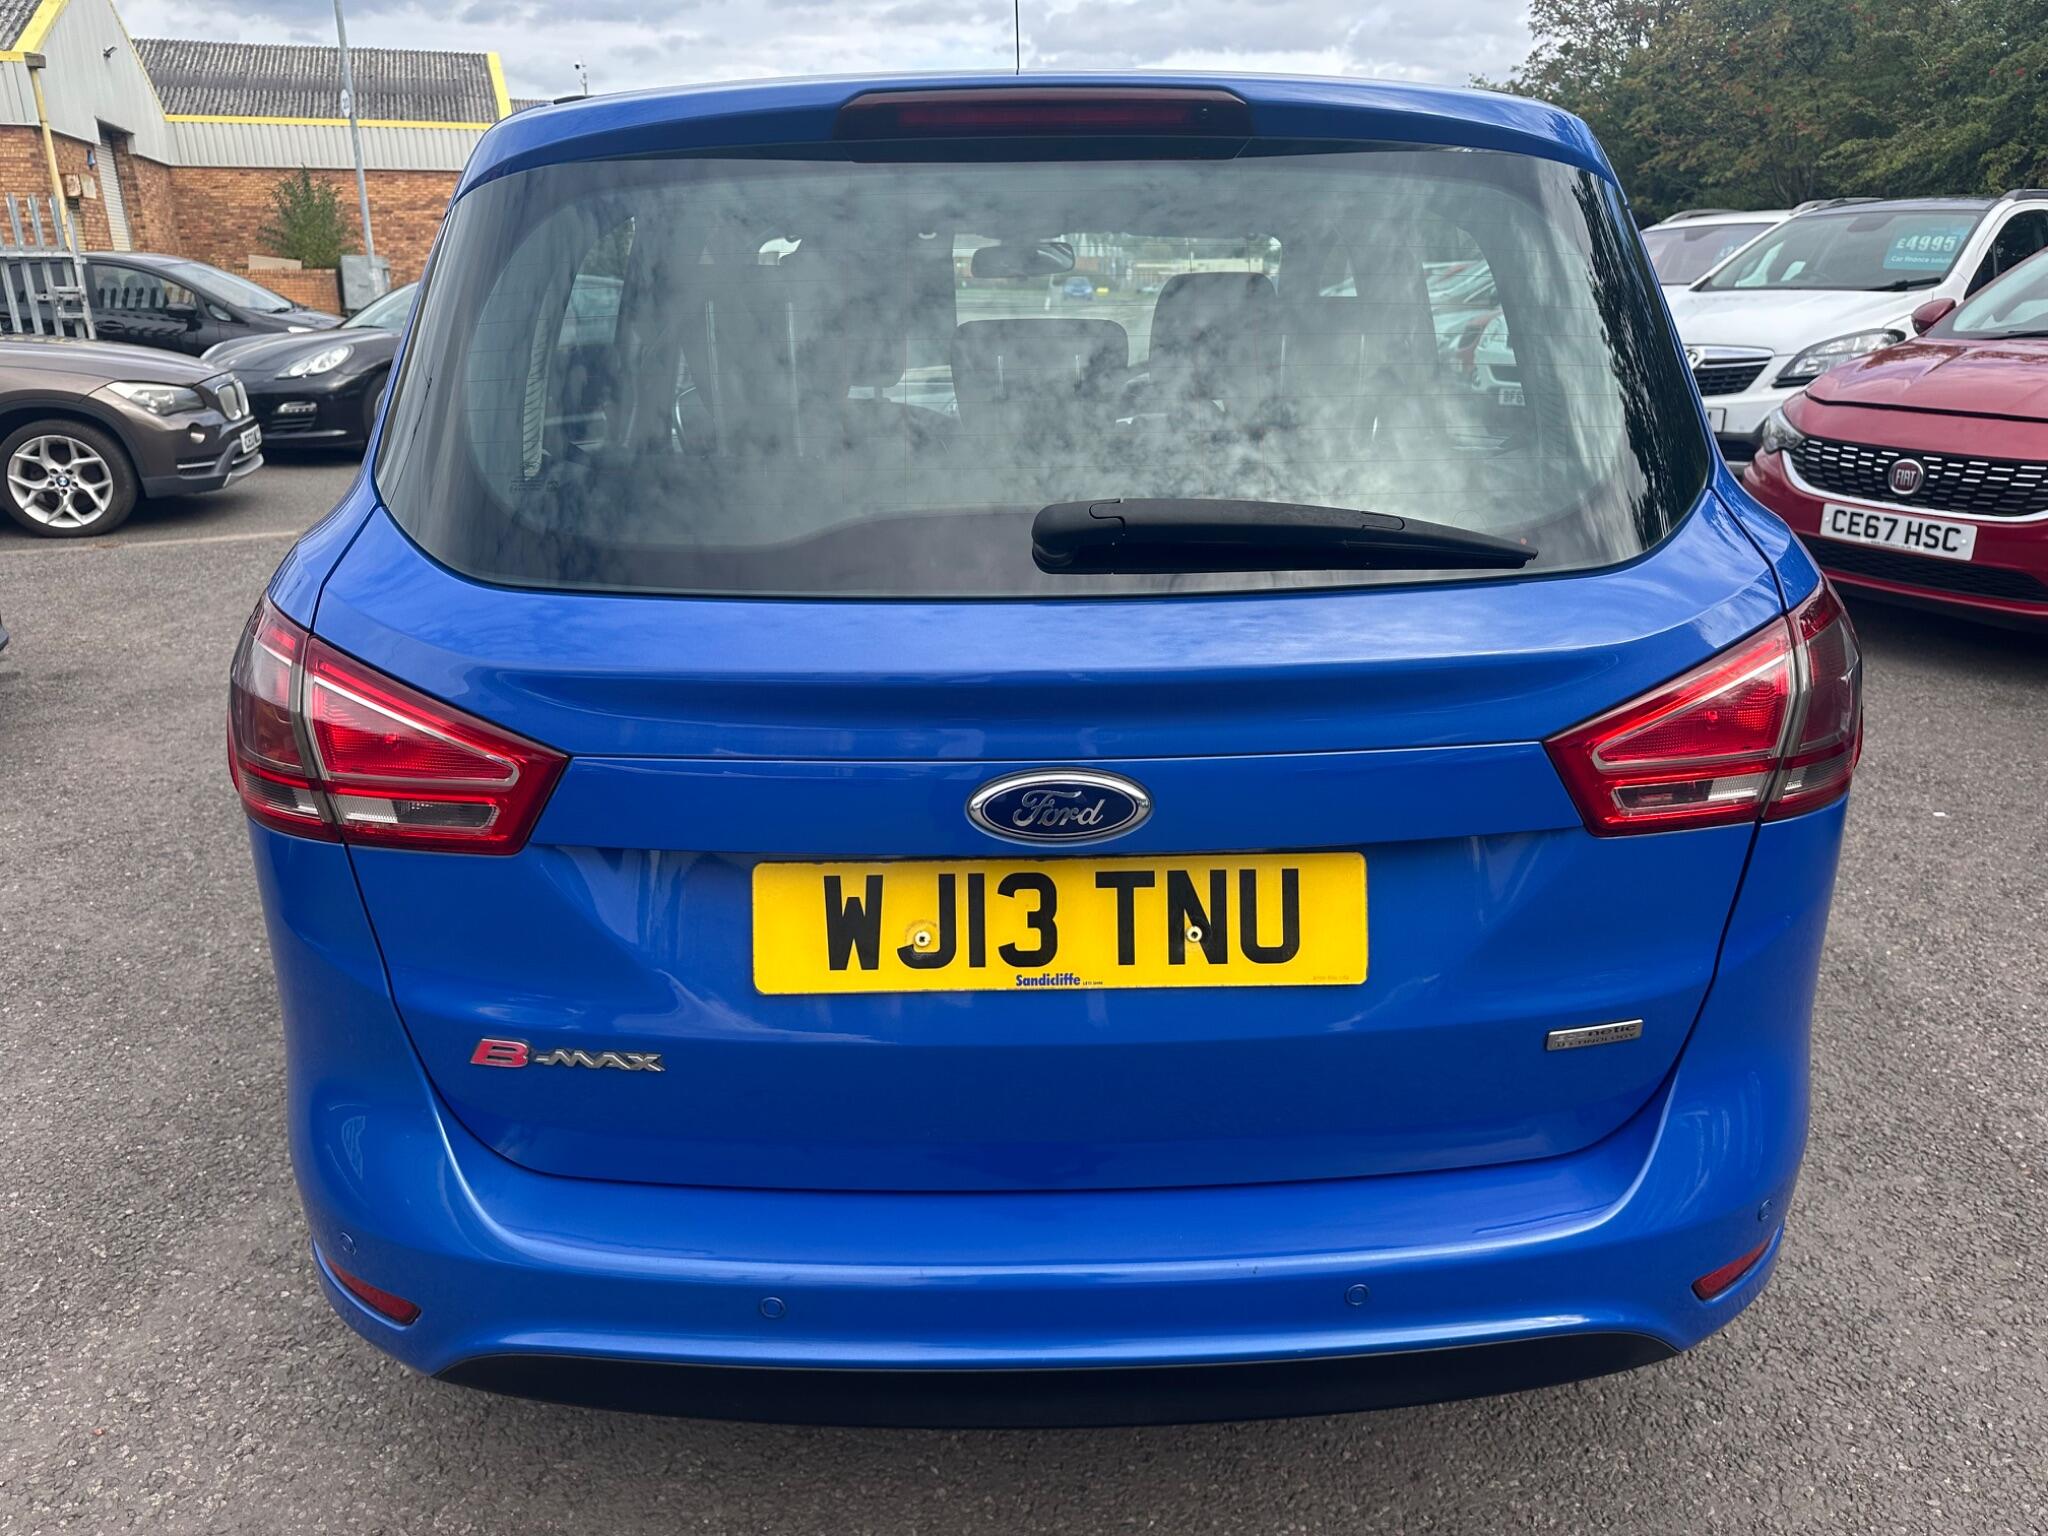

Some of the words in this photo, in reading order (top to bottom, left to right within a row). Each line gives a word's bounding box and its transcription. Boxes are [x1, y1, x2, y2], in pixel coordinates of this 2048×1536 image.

[1896, 234, 1957, 252] £4995
[1895, 468, 1917, 488] FIAT
[1831, 509, 1899, 542] CE67
[1904, 520, 1962, 553] HSC
[1011, 789, 1104, 828] Ford
[823, 872, 1059, 971] WJ13
[1095, 868, 1300, 966] TNU
[1015, 972, 1081, 987] Sandicliffe
[470, 1038, 665, 1072] B-MAX
